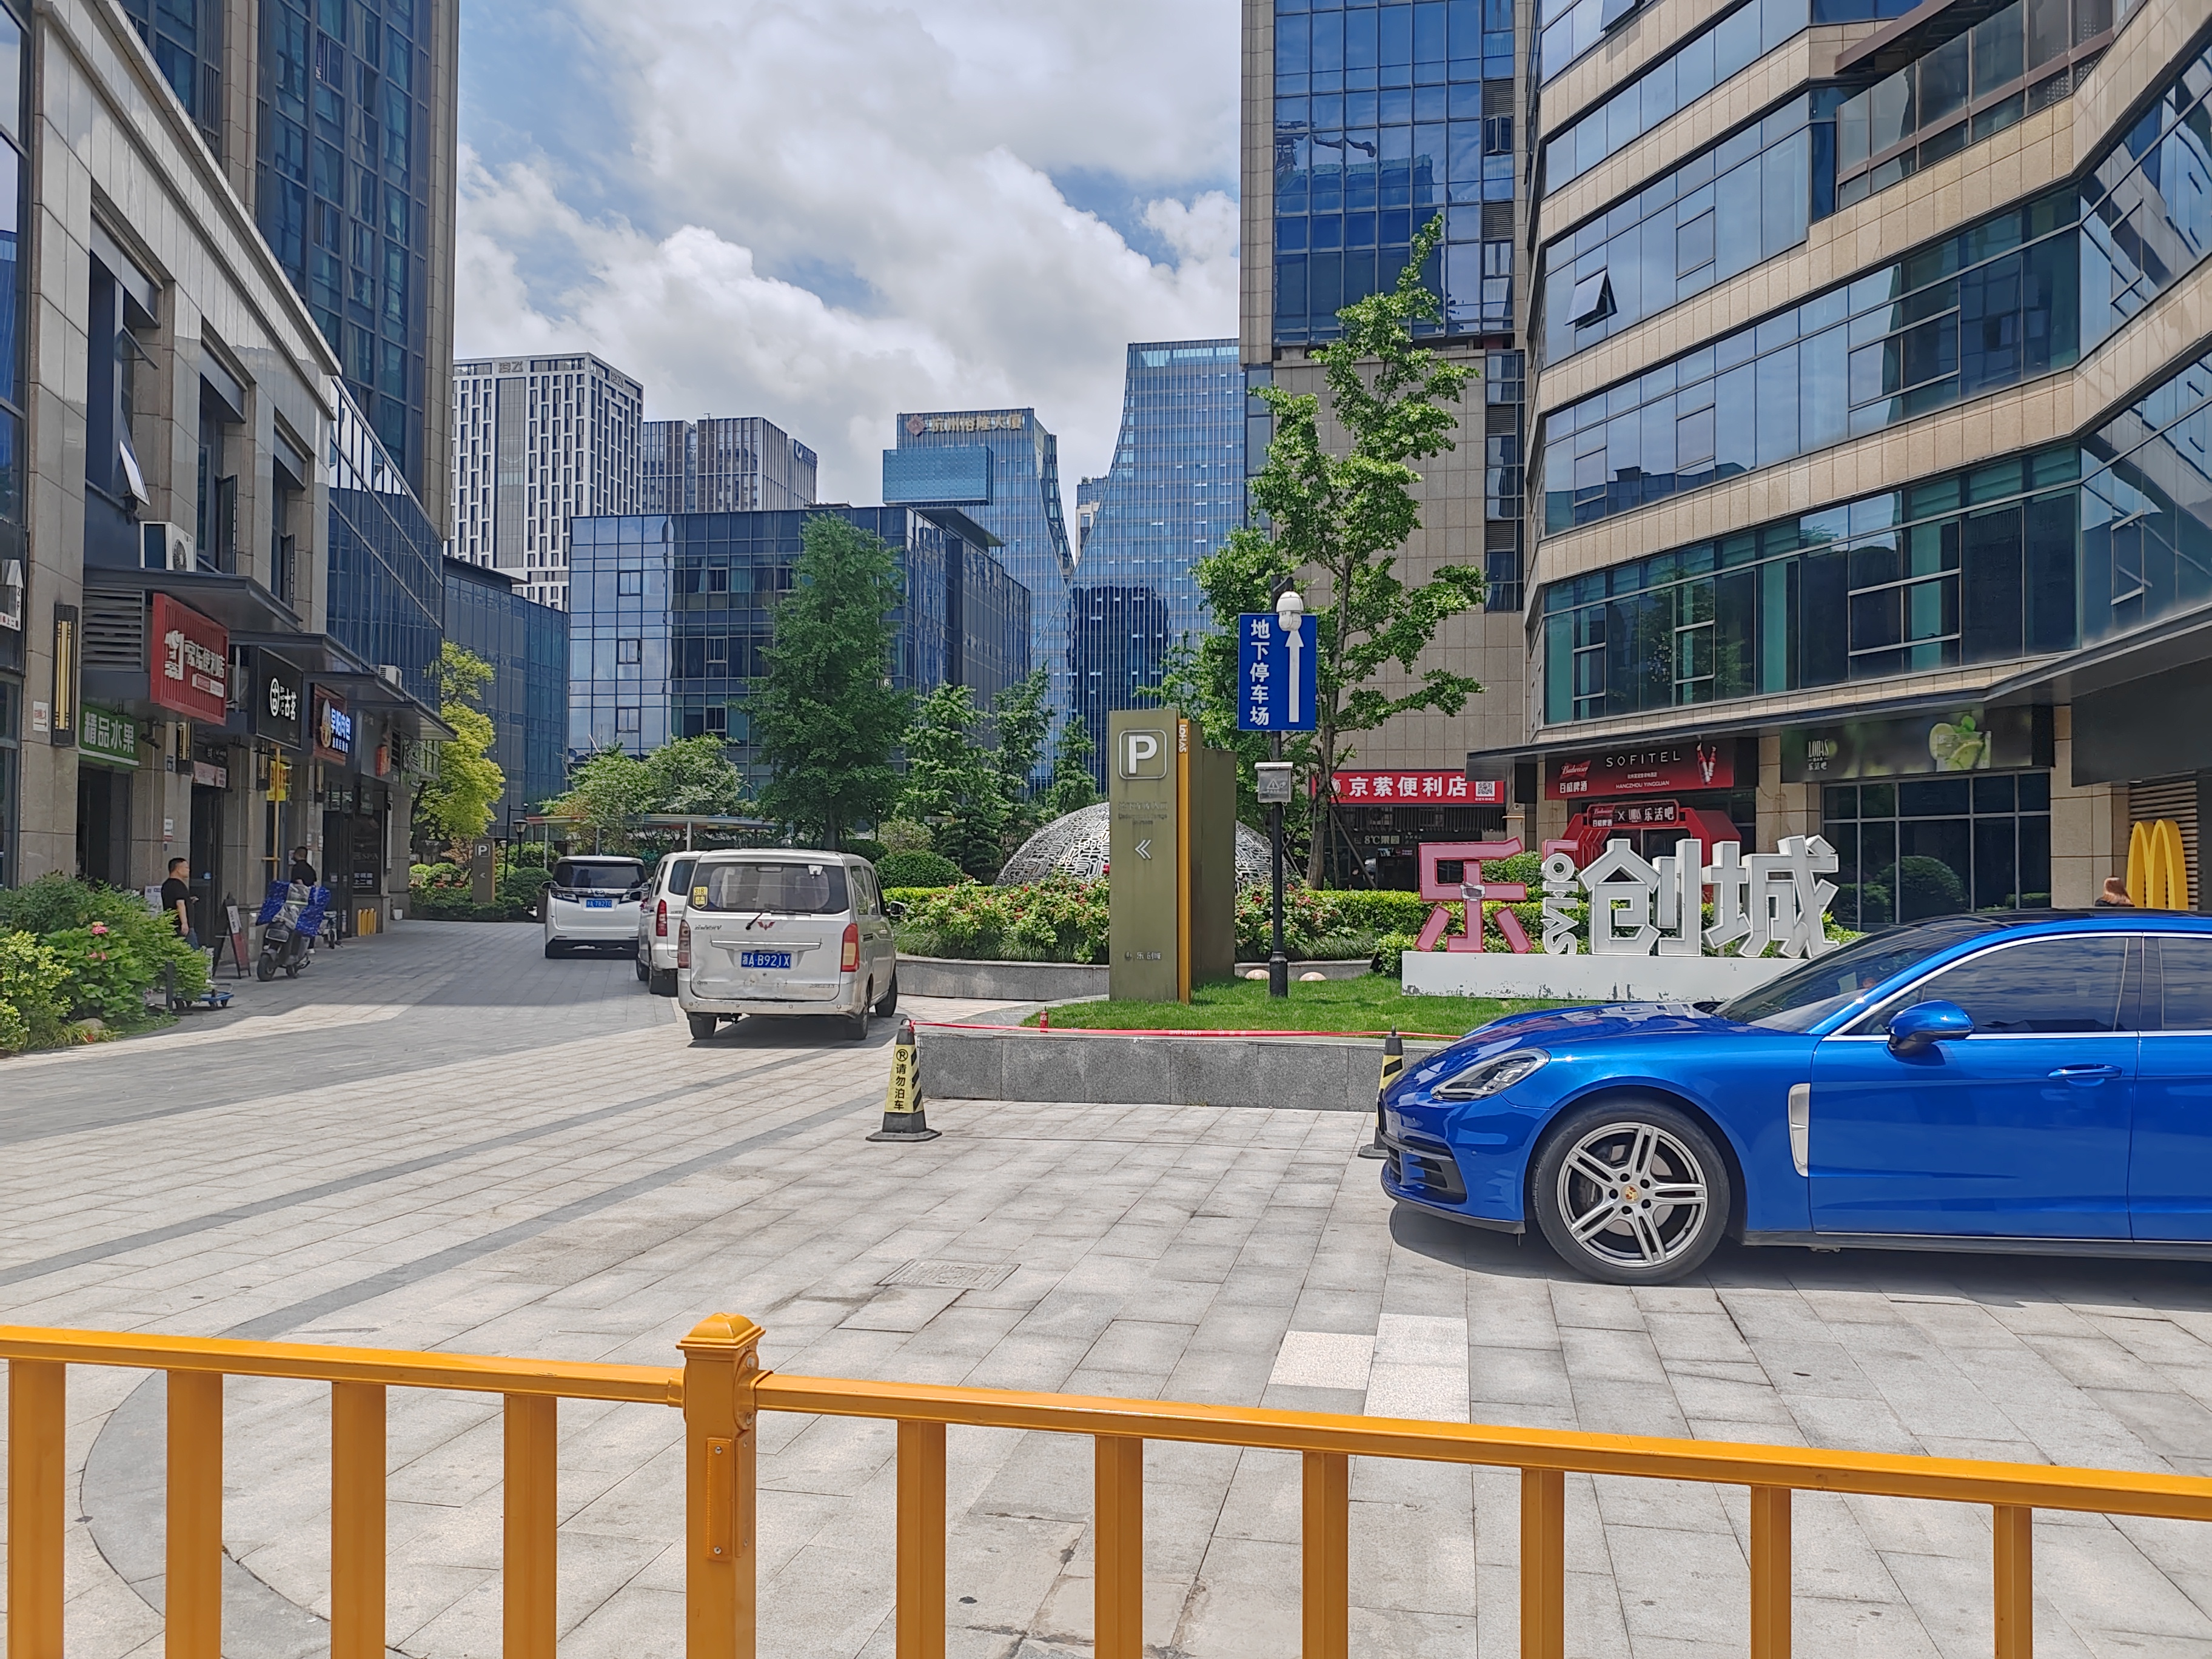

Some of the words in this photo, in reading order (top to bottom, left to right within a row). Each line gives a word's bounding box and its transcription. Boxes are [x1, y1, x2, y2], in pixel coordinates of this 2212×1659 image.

[1250, 619, 1270, 726] 地下停车场
[284, 688, 297, 720] 古茗
[84, 711, 135, 754] 精品水果
[1128, 735, 1158, 774] P
[1606, 751, 1681, 767] SOFITEL
[1561, 765, 1589, 775] Budweiser
[1560, 780, 1587, 794] 百威啤酒
[1644, 806, 1674, 822] 乐活吧
[478, 845, 488, 856] P
[893, 1064, 907, 1110] 请勿泊车
